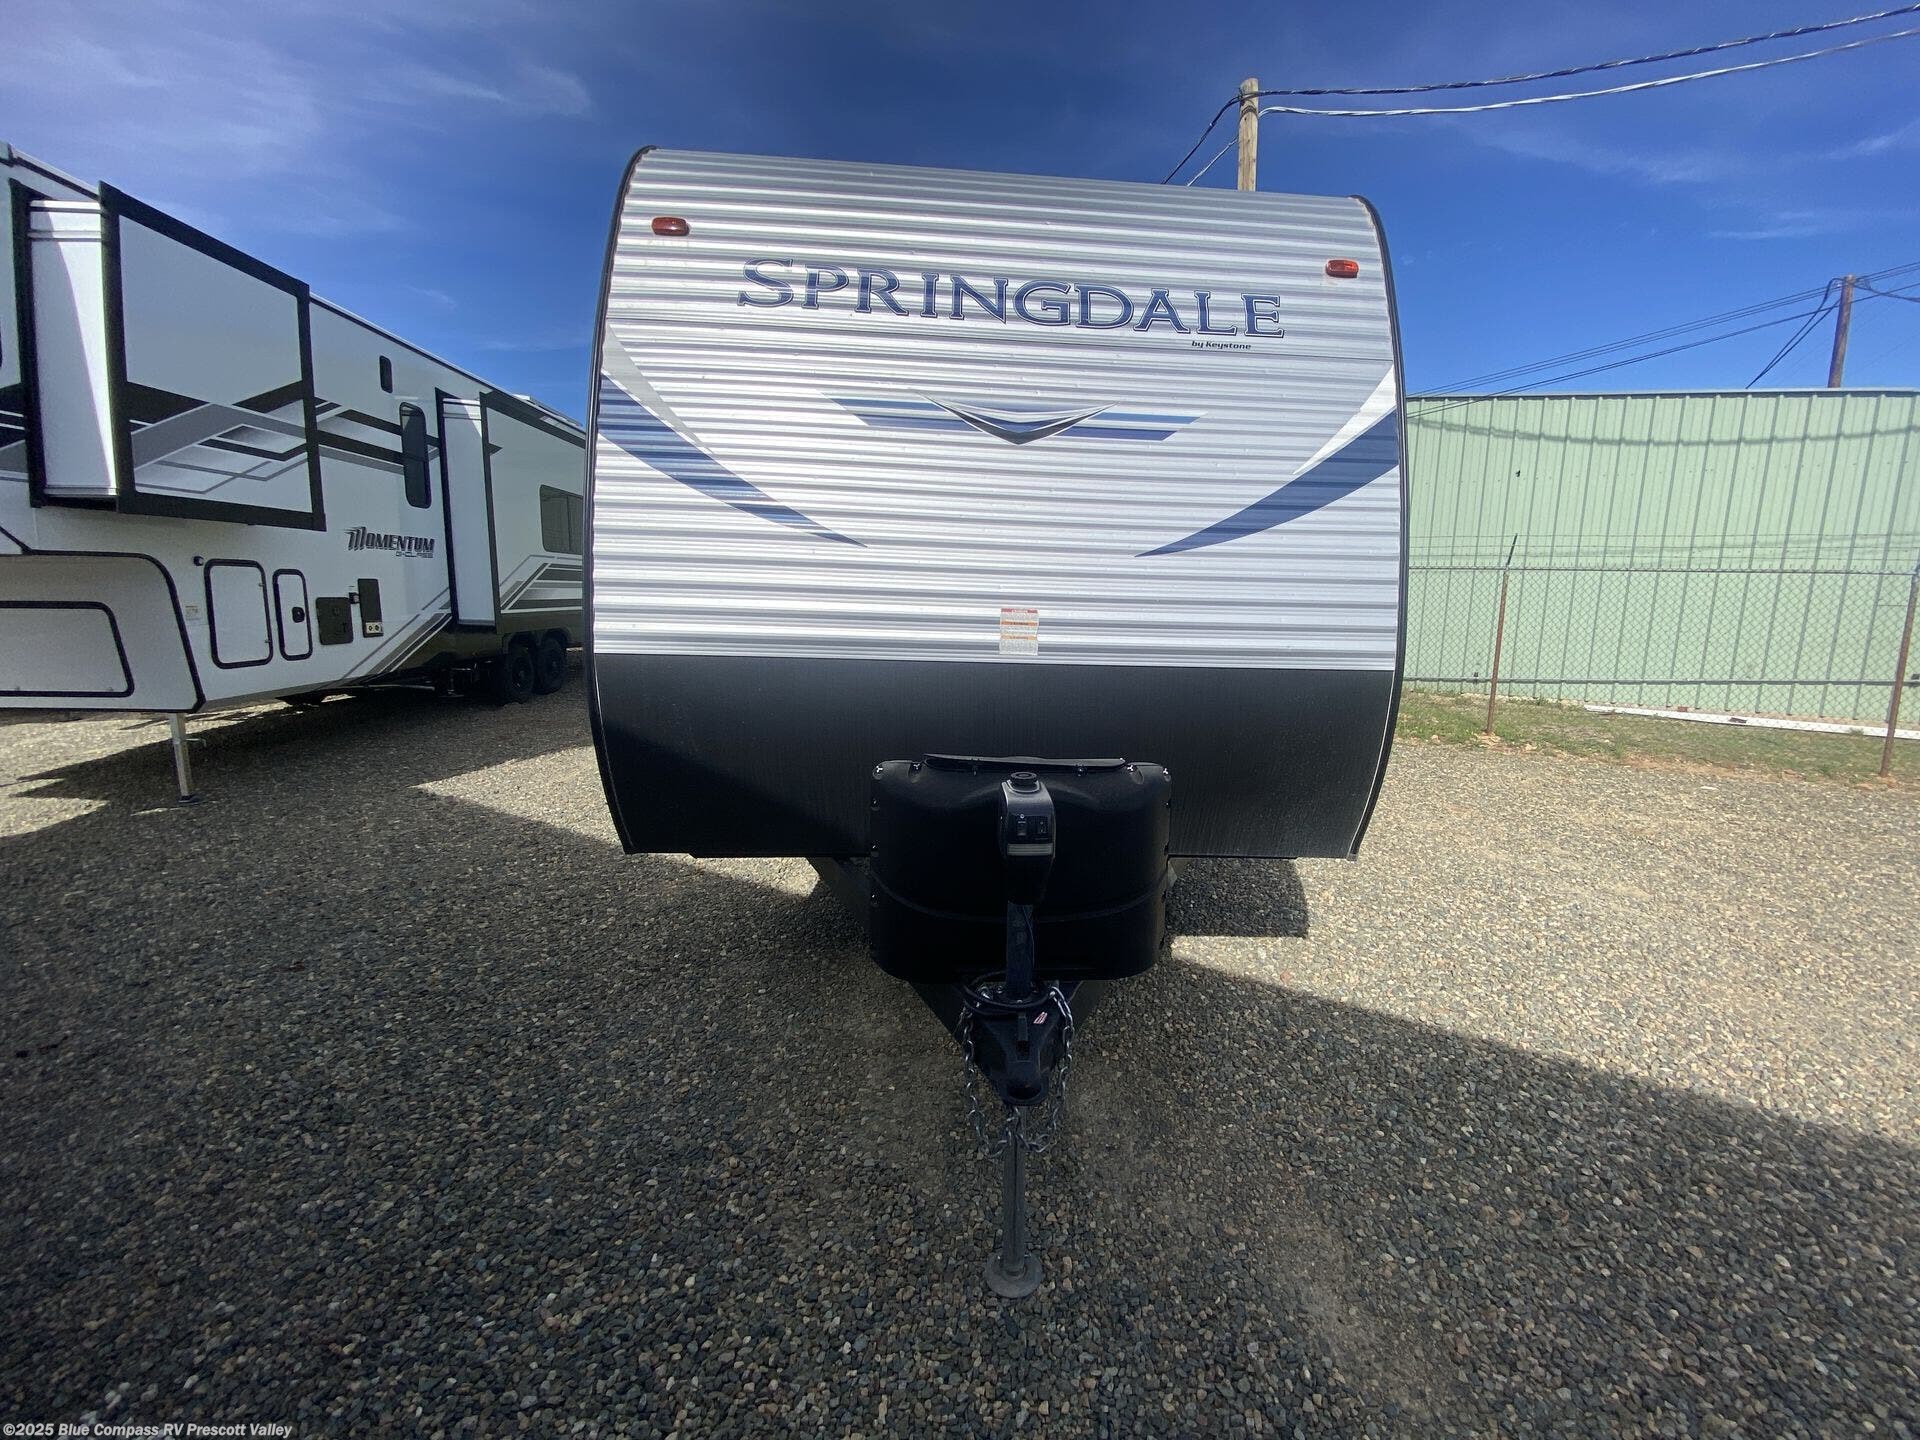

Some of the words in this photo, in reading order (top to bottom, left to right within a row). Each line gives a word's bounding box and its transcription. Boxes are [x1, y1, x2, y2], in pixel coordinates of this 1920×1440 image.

[738, 257, 1285, 338] SPRINGDALE
[1191, 340, 1204, 348] by
[1206, 341, 1252, 350] Keystone
[344, 526, 435, 552] MOMENTUM
